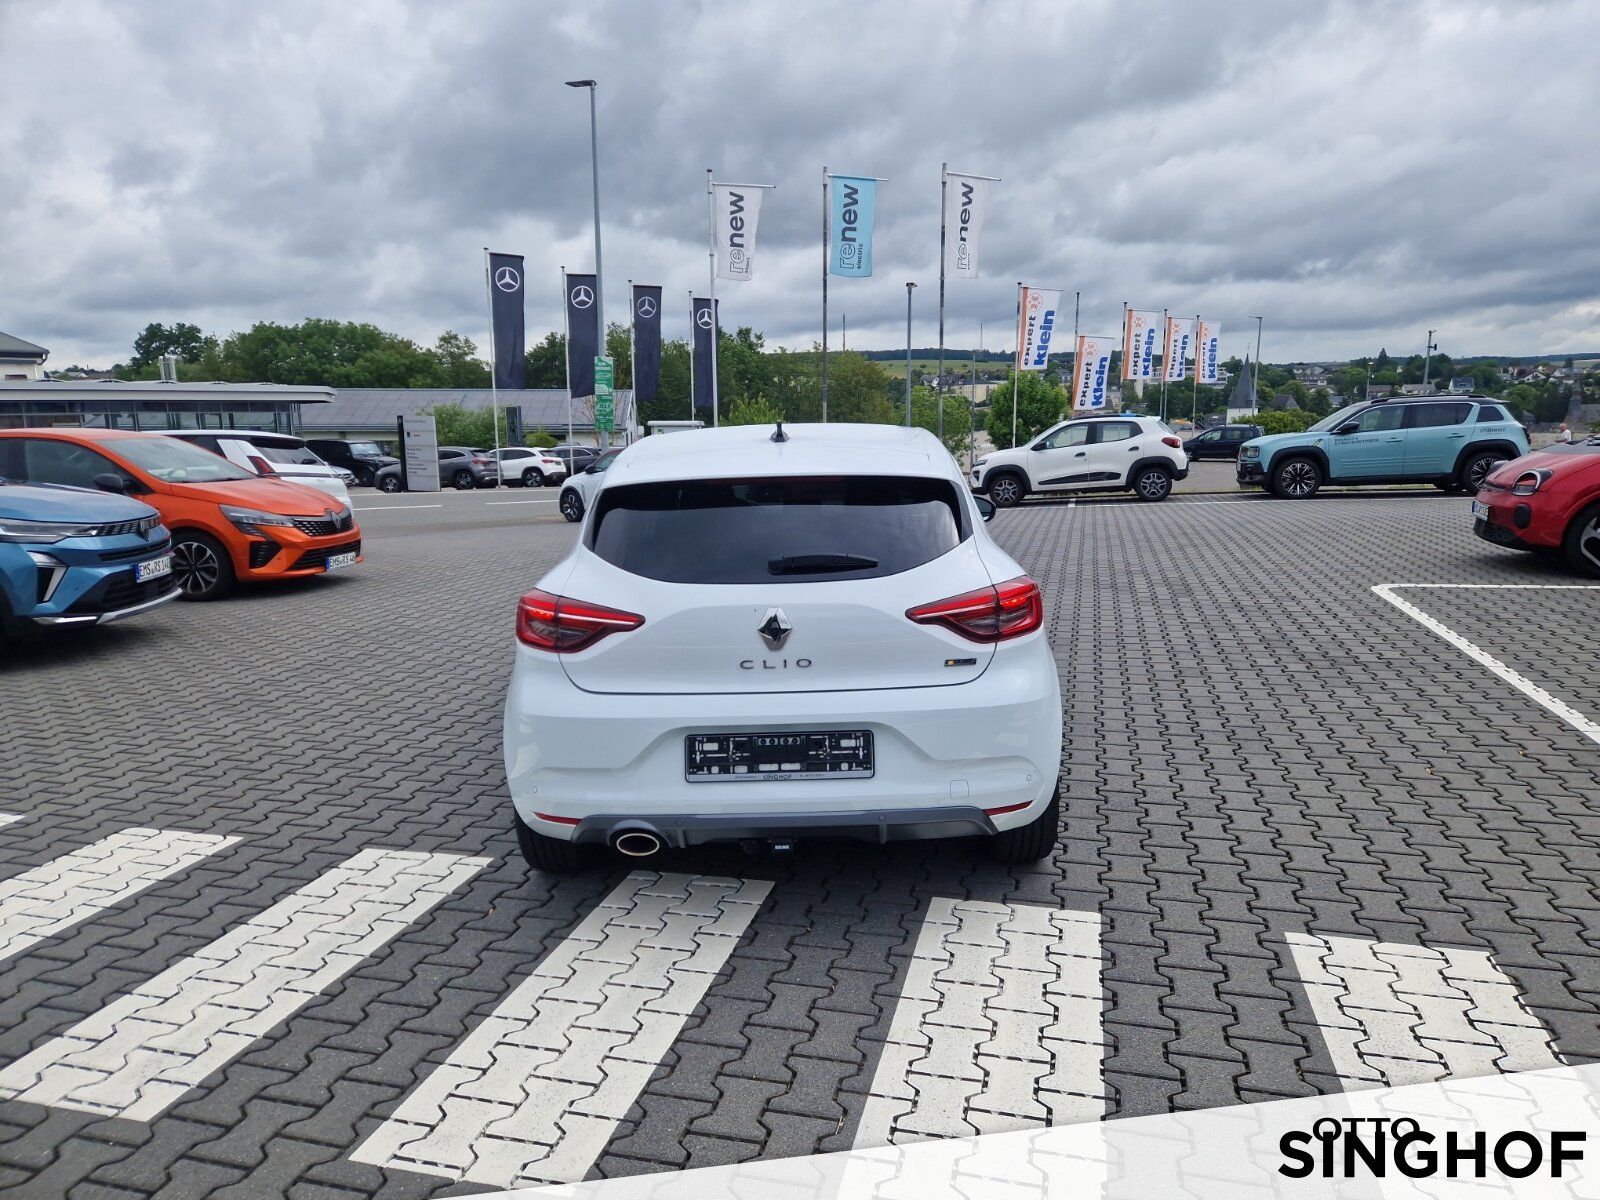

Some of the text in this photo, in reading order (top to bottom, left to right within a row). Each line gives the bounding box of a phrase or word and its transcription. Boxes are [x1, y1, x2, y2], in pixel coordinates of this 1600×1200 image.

[729, 191, 745, 274] renew
[839, 183, 859, 270] renew
[957, 181, 974, 270] renew
[1024, 315, 1036, 366] expert
[1034, 310, 1056, 366] klein
[1132, 332, 1142, 376] expert
[1142, 328, 1156, 376] klein
[1177, 334, 1189, 378] klein
[1207, 337, 1218, 379] klein
[1079, 361, 1093, 407] expert
[1091, 356, 1109, 406] klein
[139, 562, 151, 577] EMS
[739, 658, 813, 670] CLIO
